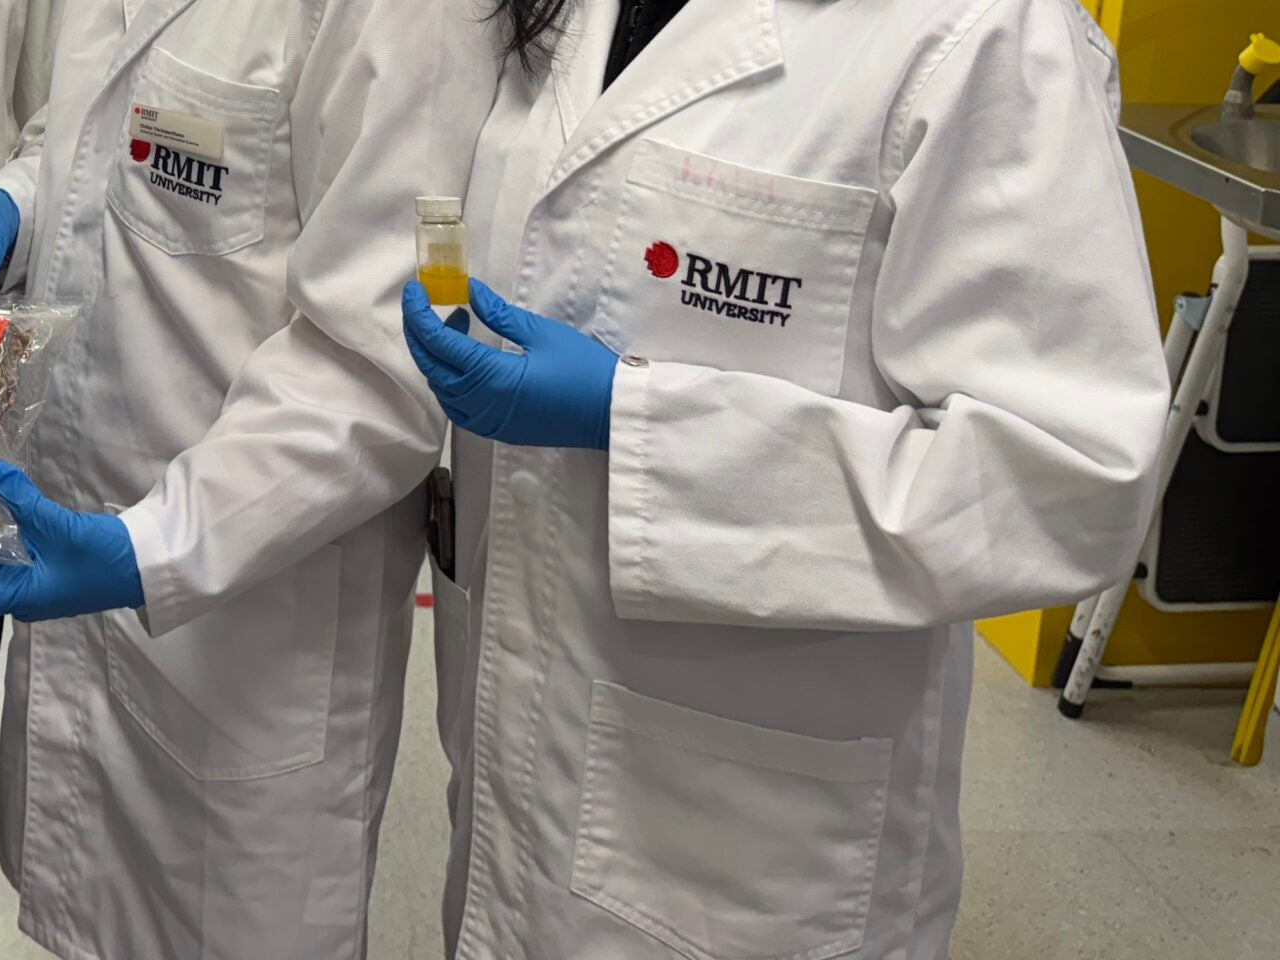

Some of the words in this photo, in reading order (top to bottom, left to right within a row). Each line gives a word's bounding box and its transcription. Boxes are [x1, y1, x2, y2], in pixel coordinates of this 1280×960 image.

[141, 108, 159, 119] RMIT
[150, 143, 230, 192] RMIT
[150, 171, 223, 206] UNIVERSITY
[681, 252, 803, 310] RMIT
[681, 289, 791, 328] UNIVERSITY
